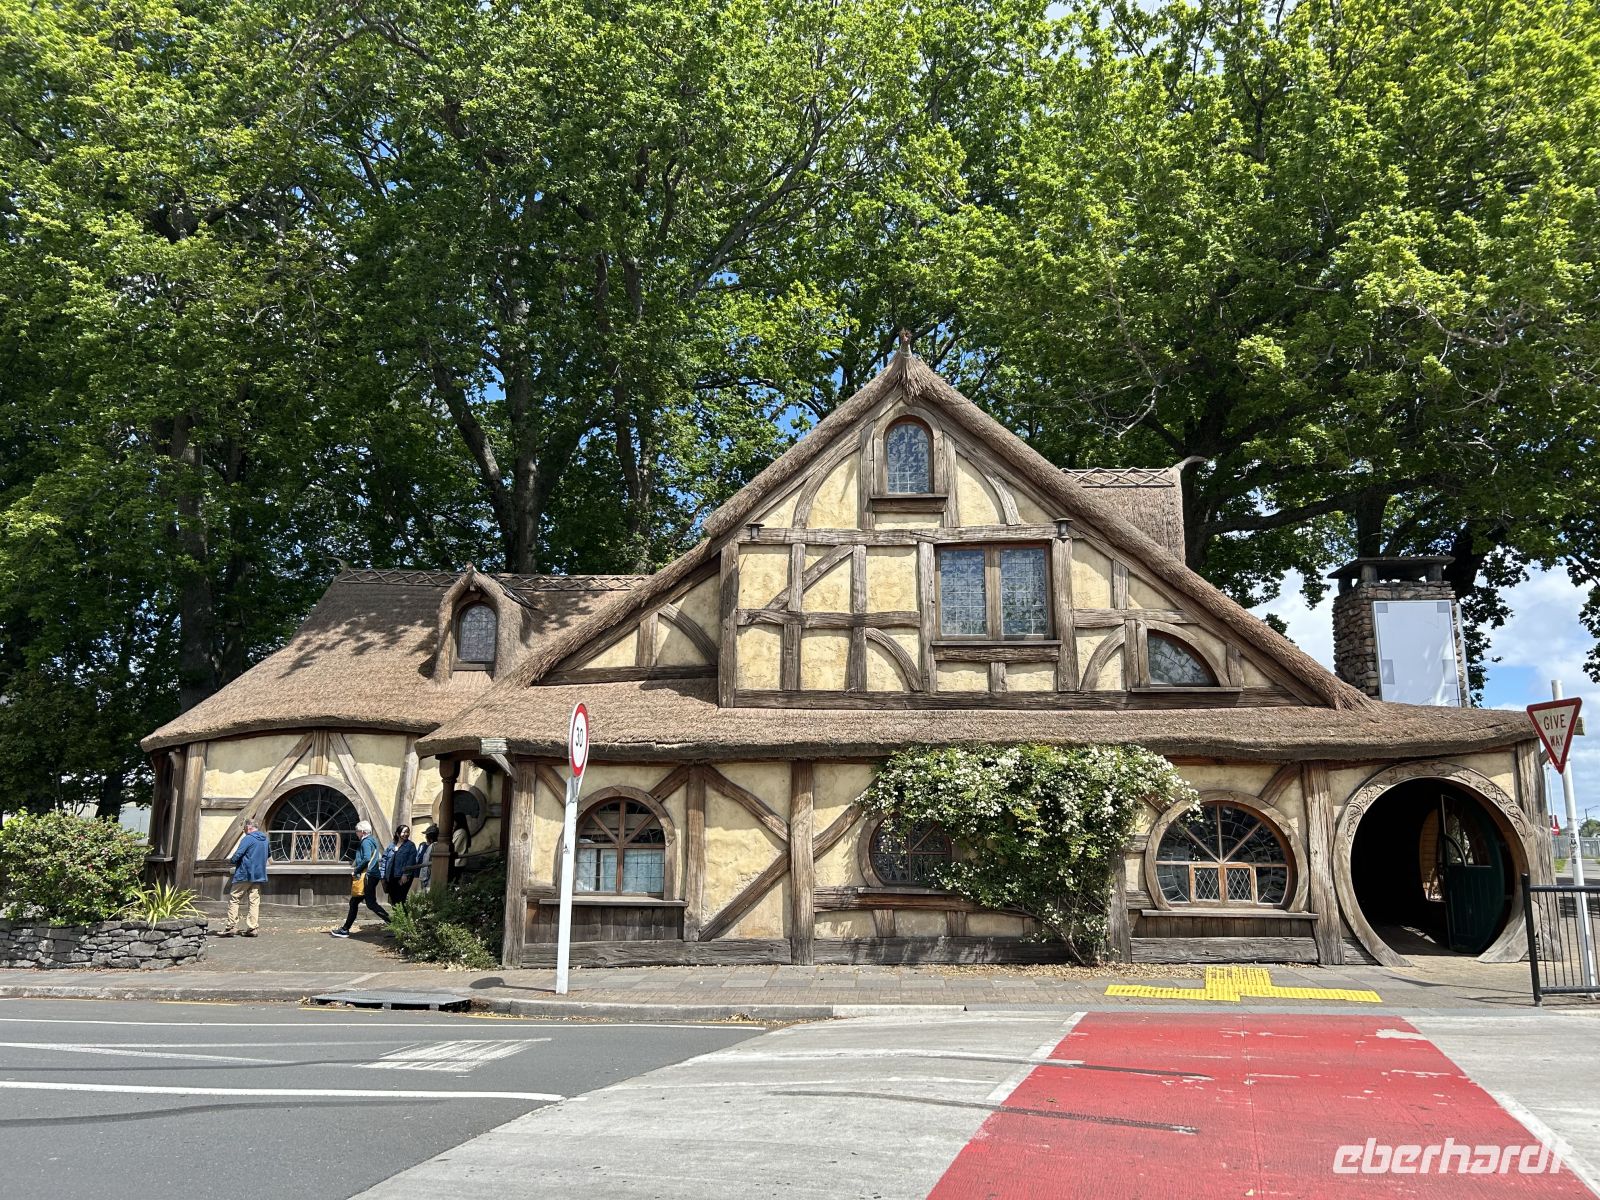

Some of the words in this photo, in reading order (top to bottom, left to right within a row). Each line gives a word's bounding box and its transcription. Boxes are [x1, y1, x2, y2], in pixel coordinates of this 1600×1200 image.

[1543, 714, 1567, 731] GIVE
[575, 726, 584, 748] 30
[1549, 735, 1564, 747] WAY
